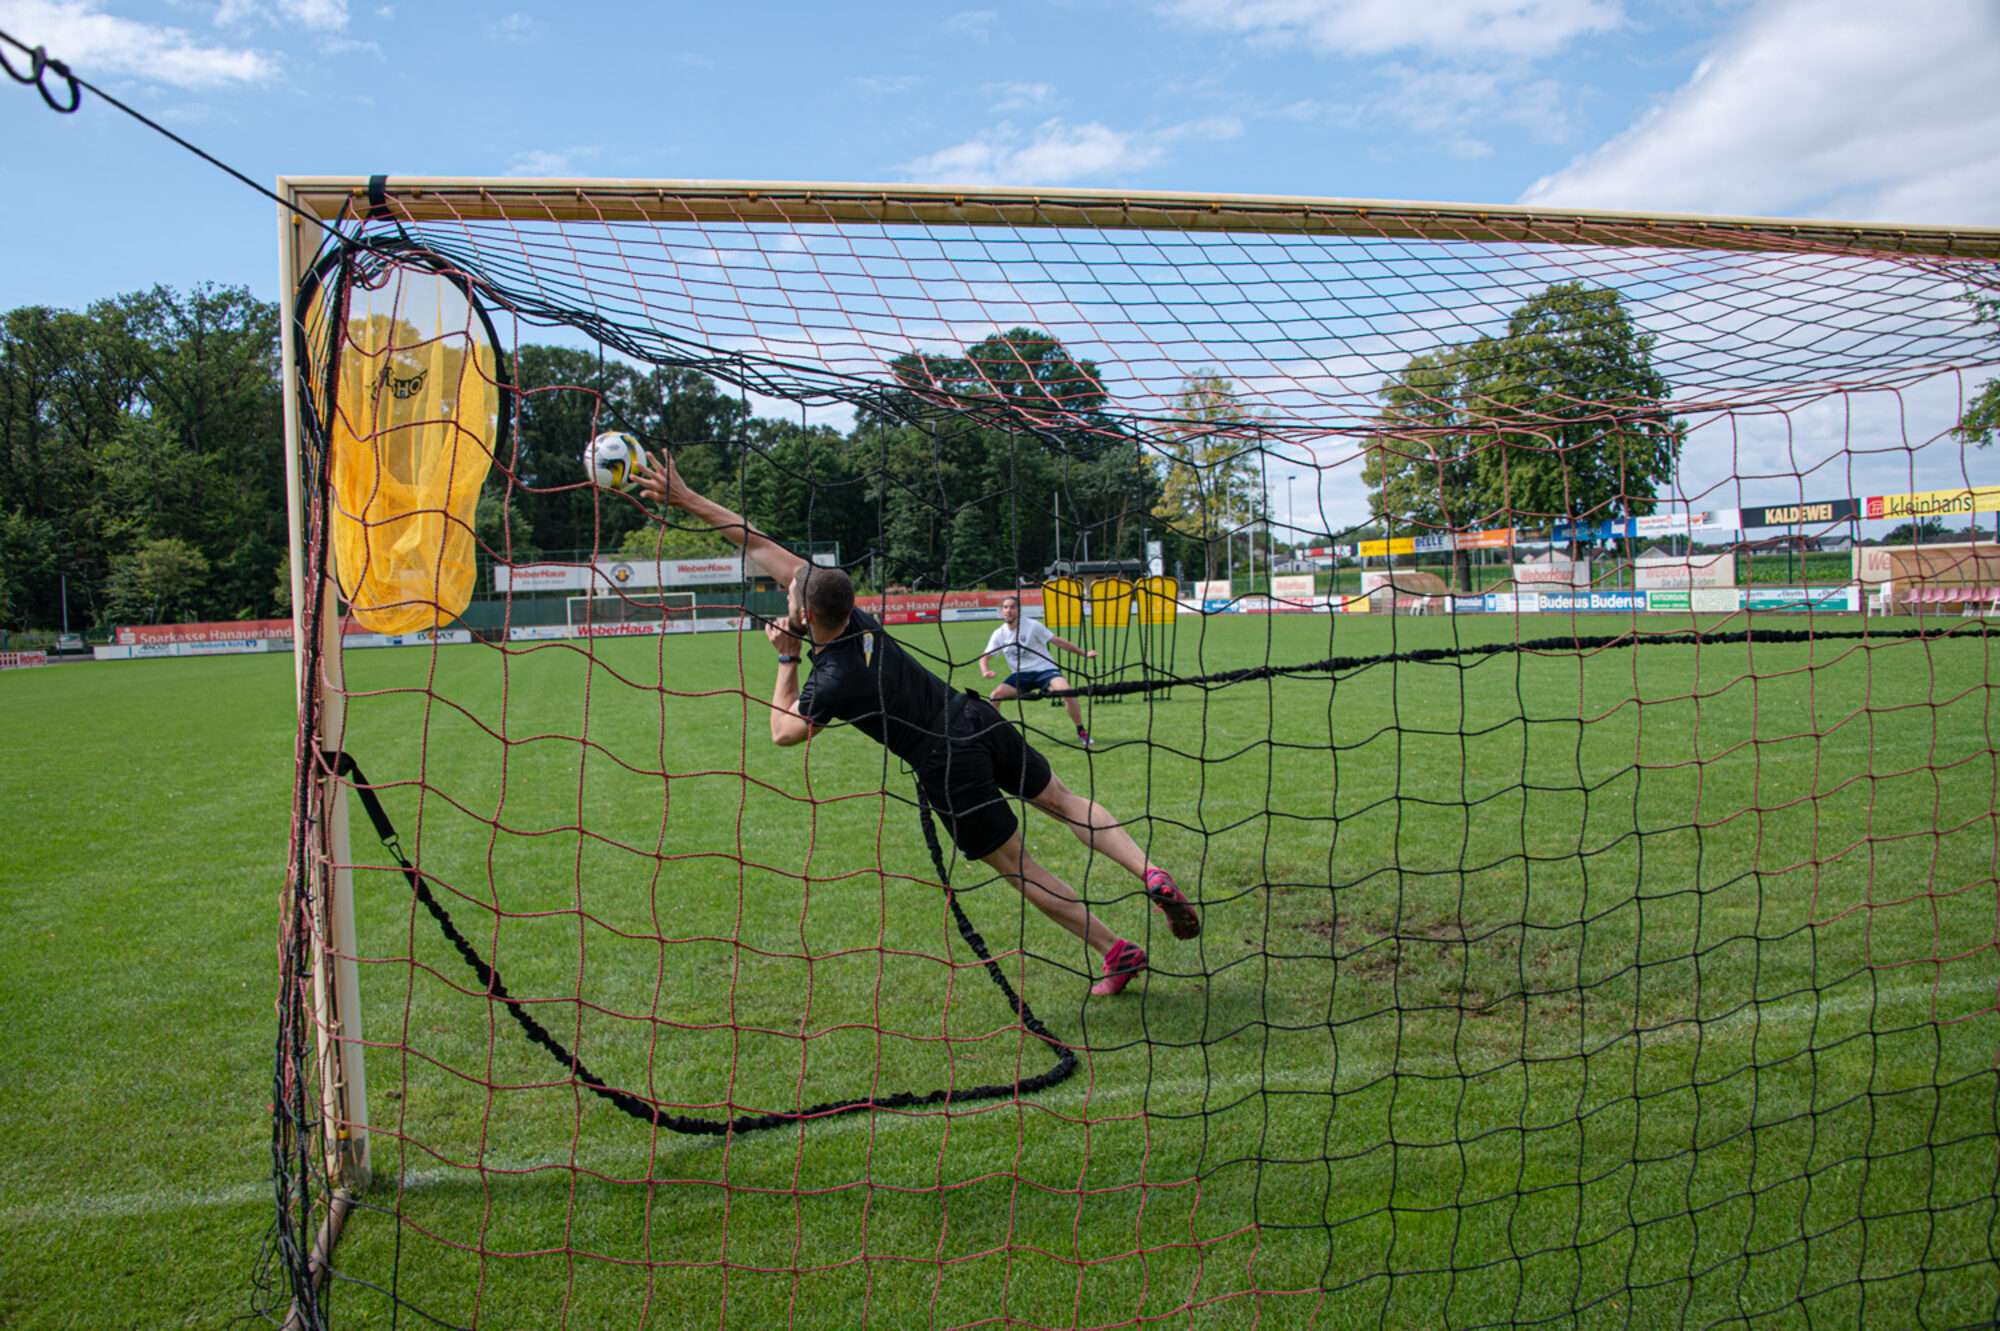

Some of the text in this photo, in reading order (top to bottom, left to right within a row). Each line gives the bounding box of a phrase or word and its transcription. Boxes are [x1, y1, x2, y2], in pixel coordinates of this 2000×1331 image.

[1764, 503, 1833, 525] KALDEWEI
[1890, 493, 1973, 517] kleinhans
[1590, 593, 1645, 609] Buderus
[140, 626, 292, 644] Sparkasse Hanauerland
[577, 623, 654, 636] WeberHaus
